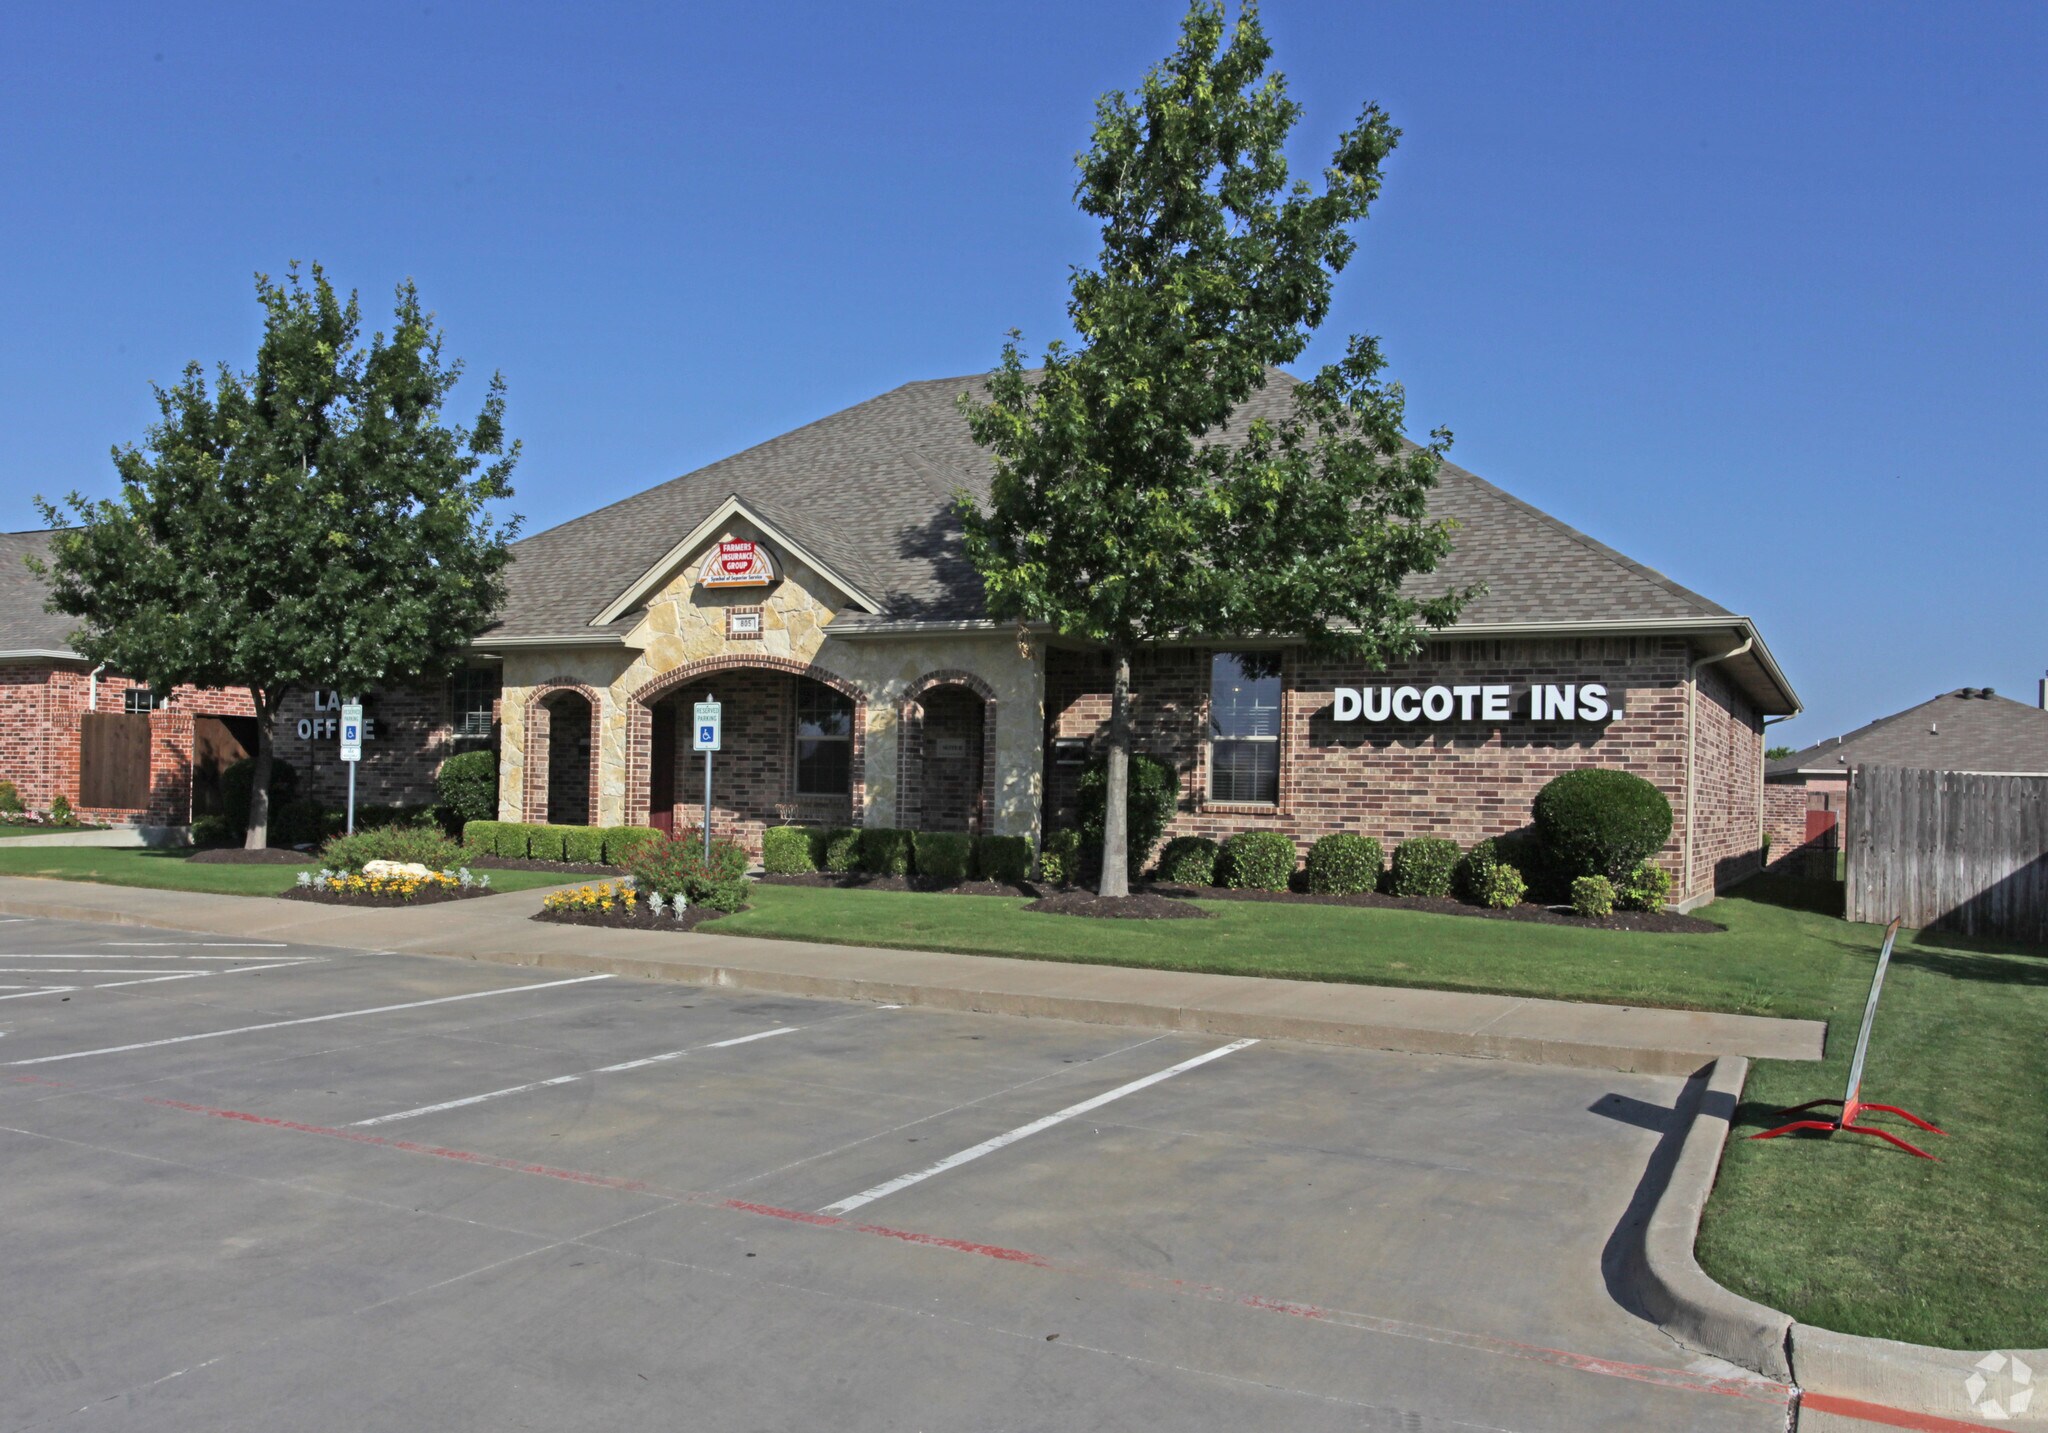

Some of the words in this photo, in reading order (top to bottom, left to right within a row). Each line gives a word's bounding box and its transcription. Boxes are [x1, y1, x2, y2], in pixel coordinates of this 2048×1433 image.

[723, 543, 751, 552] FARMERS
[722, 552, 753, 560] INSURANCE
[727, 561, 748, 570] GROUP
[740, 619, 752, 627] 805
[1334, 685, 1511, 722] DUCOTE
[1531, 684, 1623, 721] INS.
[297, 719, 375, 740] OFFE
